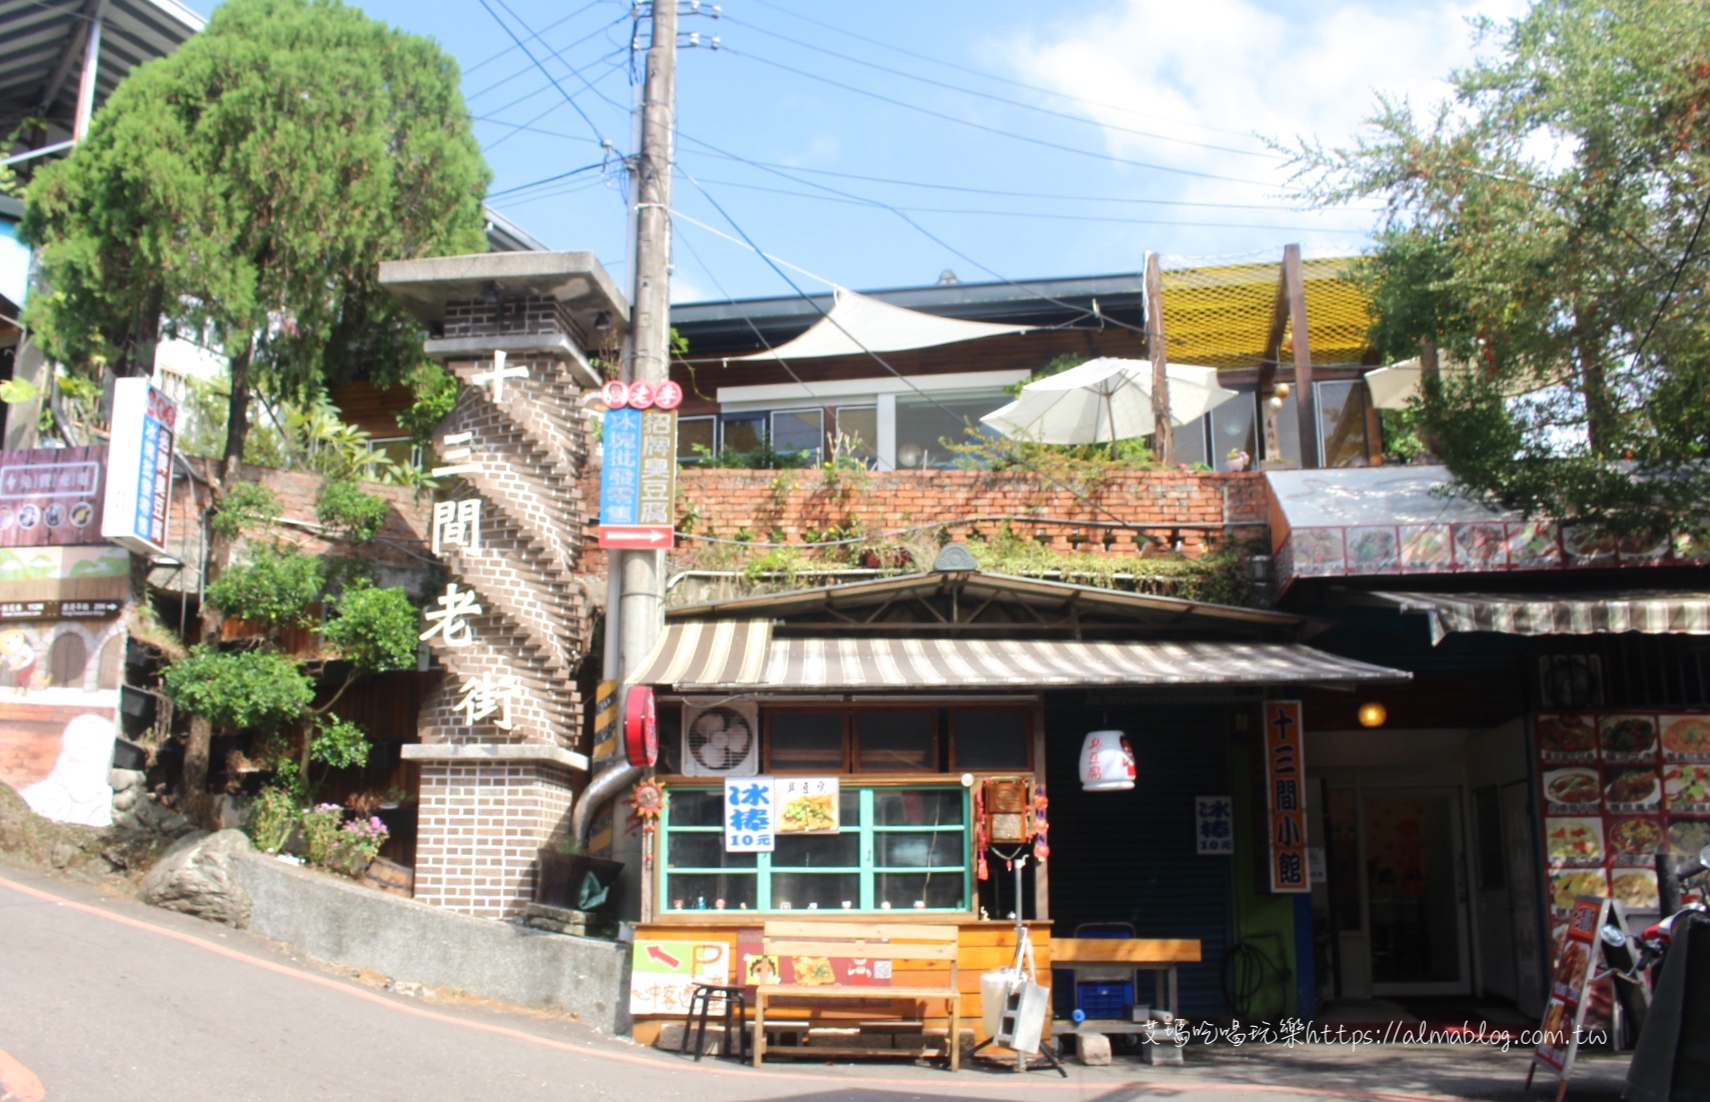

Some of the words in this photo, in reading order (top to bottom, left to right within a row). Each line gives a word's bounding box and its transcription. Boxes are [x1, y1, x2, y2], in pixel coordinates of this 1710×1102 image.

[419, 350, 530, 730] 十三間老街
[728, 783, 770, 832] 冰棒
[1273, 708, 1302, 884] 十三間小館
[730, 834, 771, 846] 10元
[1198, 801, 1231, 839] 冰棒
[691, 944, 723, 979] P
